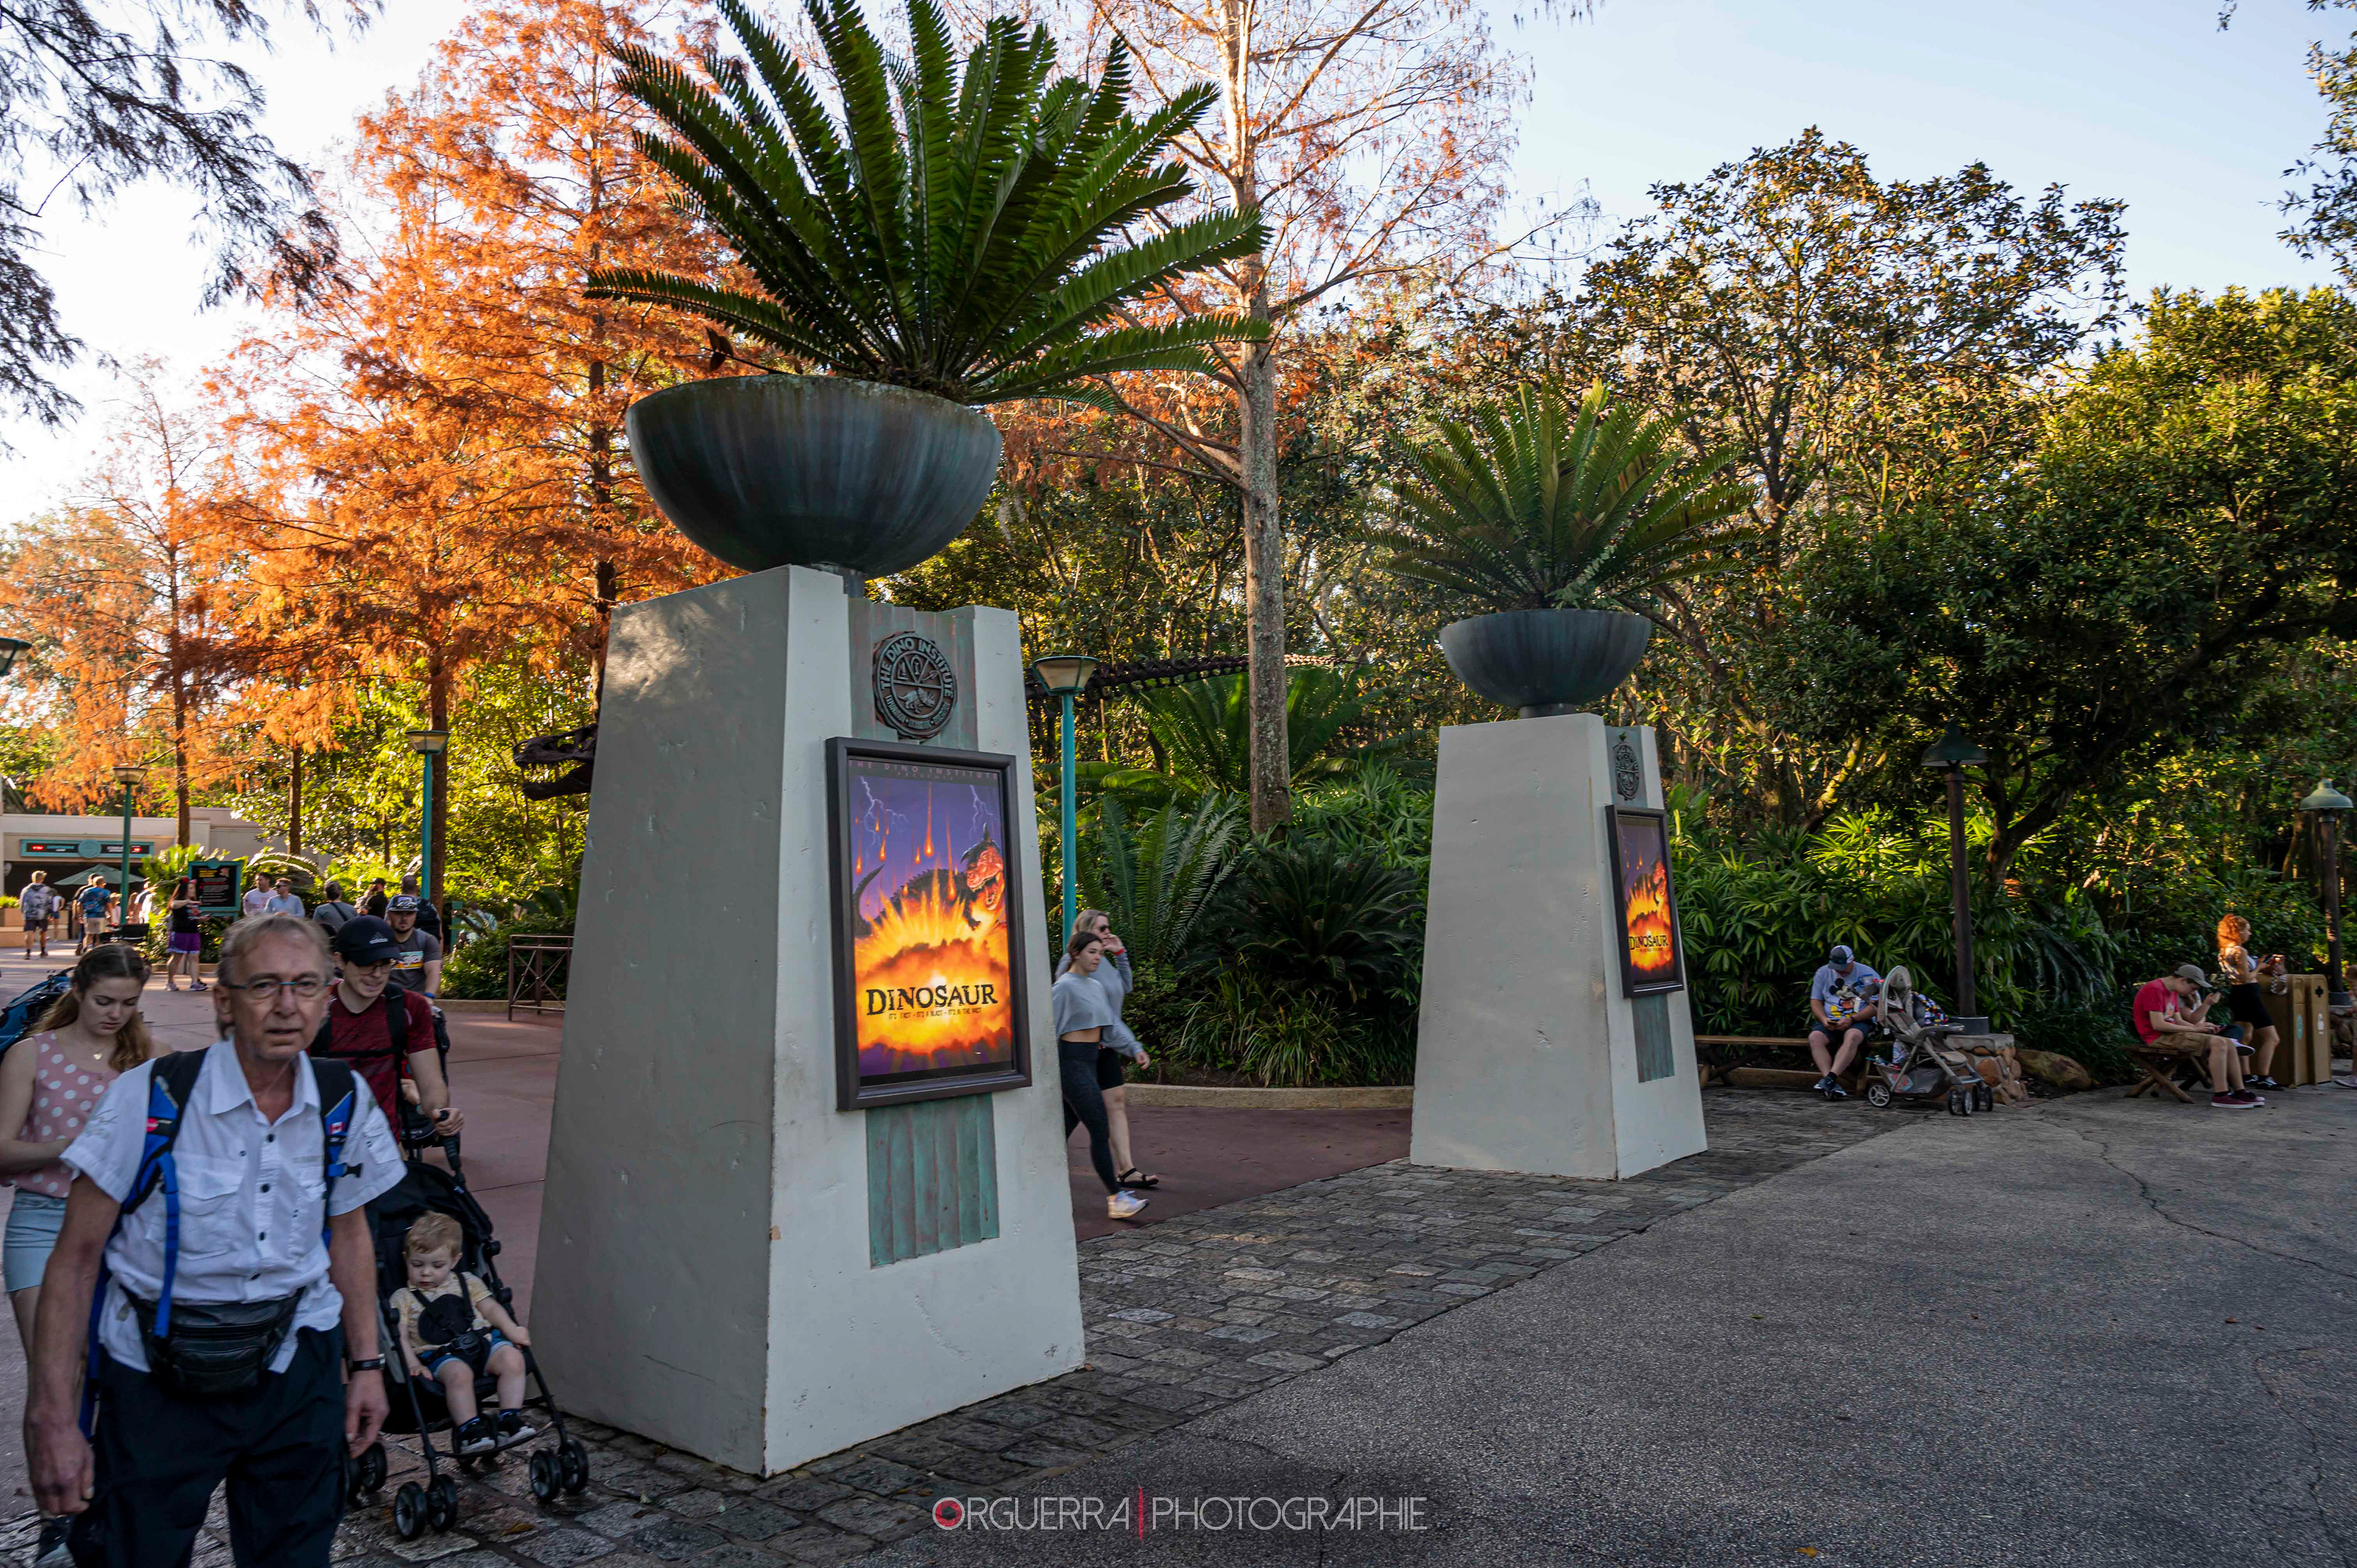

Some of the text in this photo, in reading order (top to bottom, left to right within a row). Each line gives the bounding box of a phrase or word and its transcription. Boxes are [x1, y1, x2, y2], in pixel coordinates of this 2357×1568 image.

[880, 638, 954, 698] THE DINO INSTITUTE
[884, 762, 918, 773] DINO
[1628, 935, 1668, 950] DINOSAUR
[866, 984, 998, 1016] DINOSAUR
